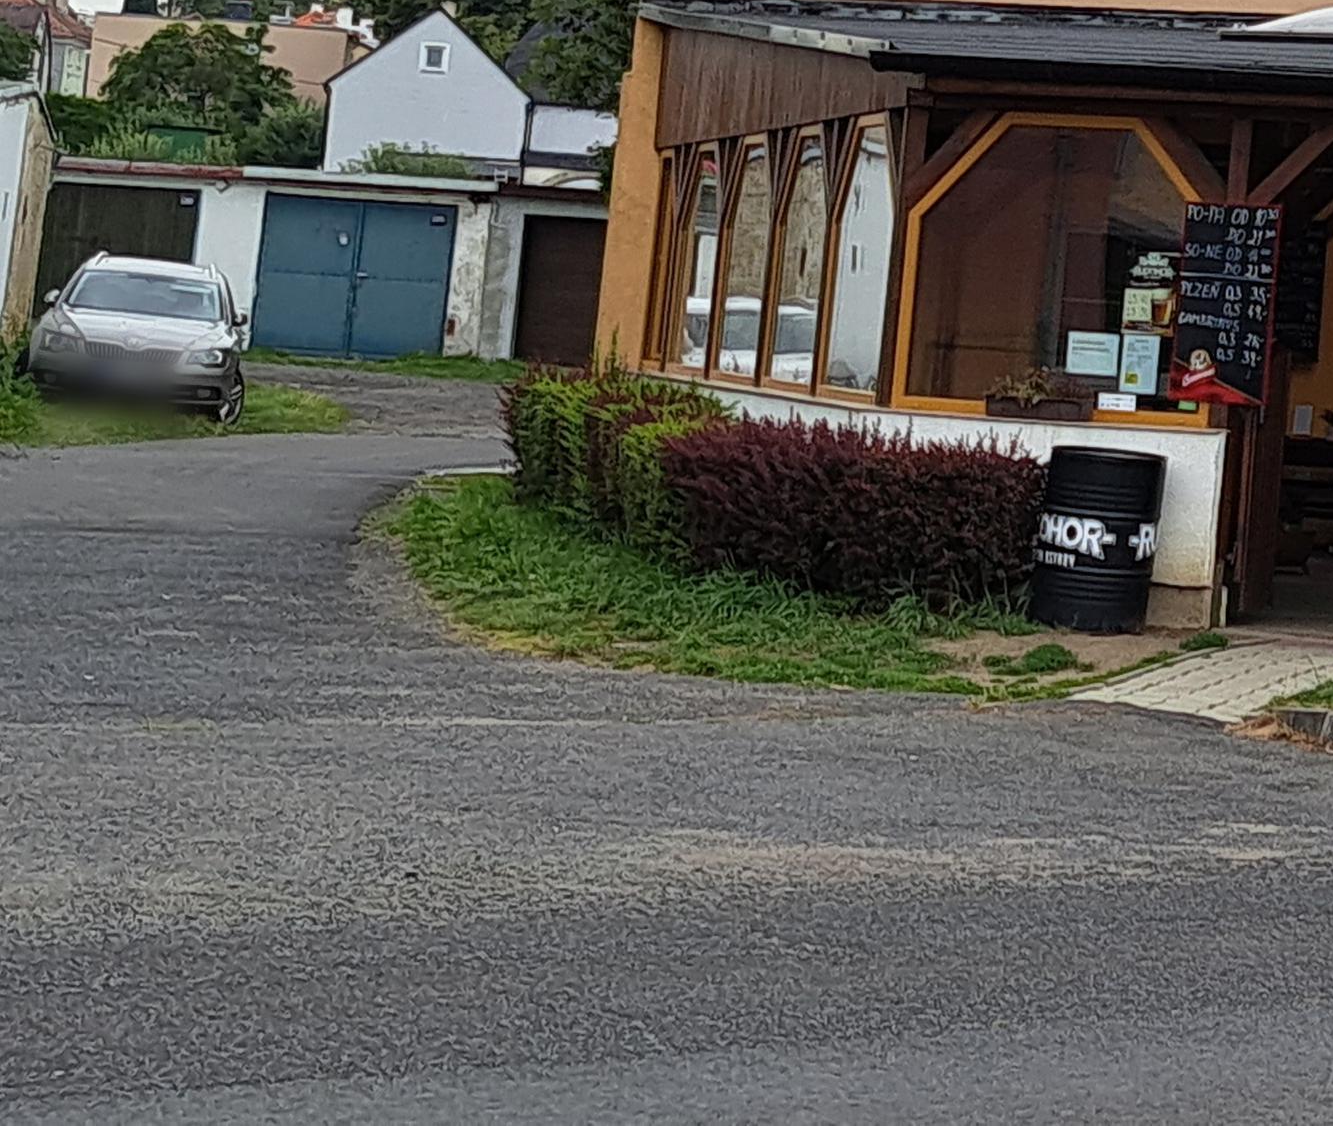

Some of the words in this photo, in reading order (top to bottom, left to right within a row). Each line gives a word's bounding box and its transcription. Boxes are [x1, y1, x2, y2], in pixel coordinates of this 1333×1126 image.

[1231, 207, 1249, 225] OD
[1225, 226, 1247, 245] DO
[1184, 242, 1223, 260] SO-NE
[1225, 246, 1243, 261] OD
[1222, 262, 1242, 276] DO
[1180, 280, 1222, 299] PLZEŇ
